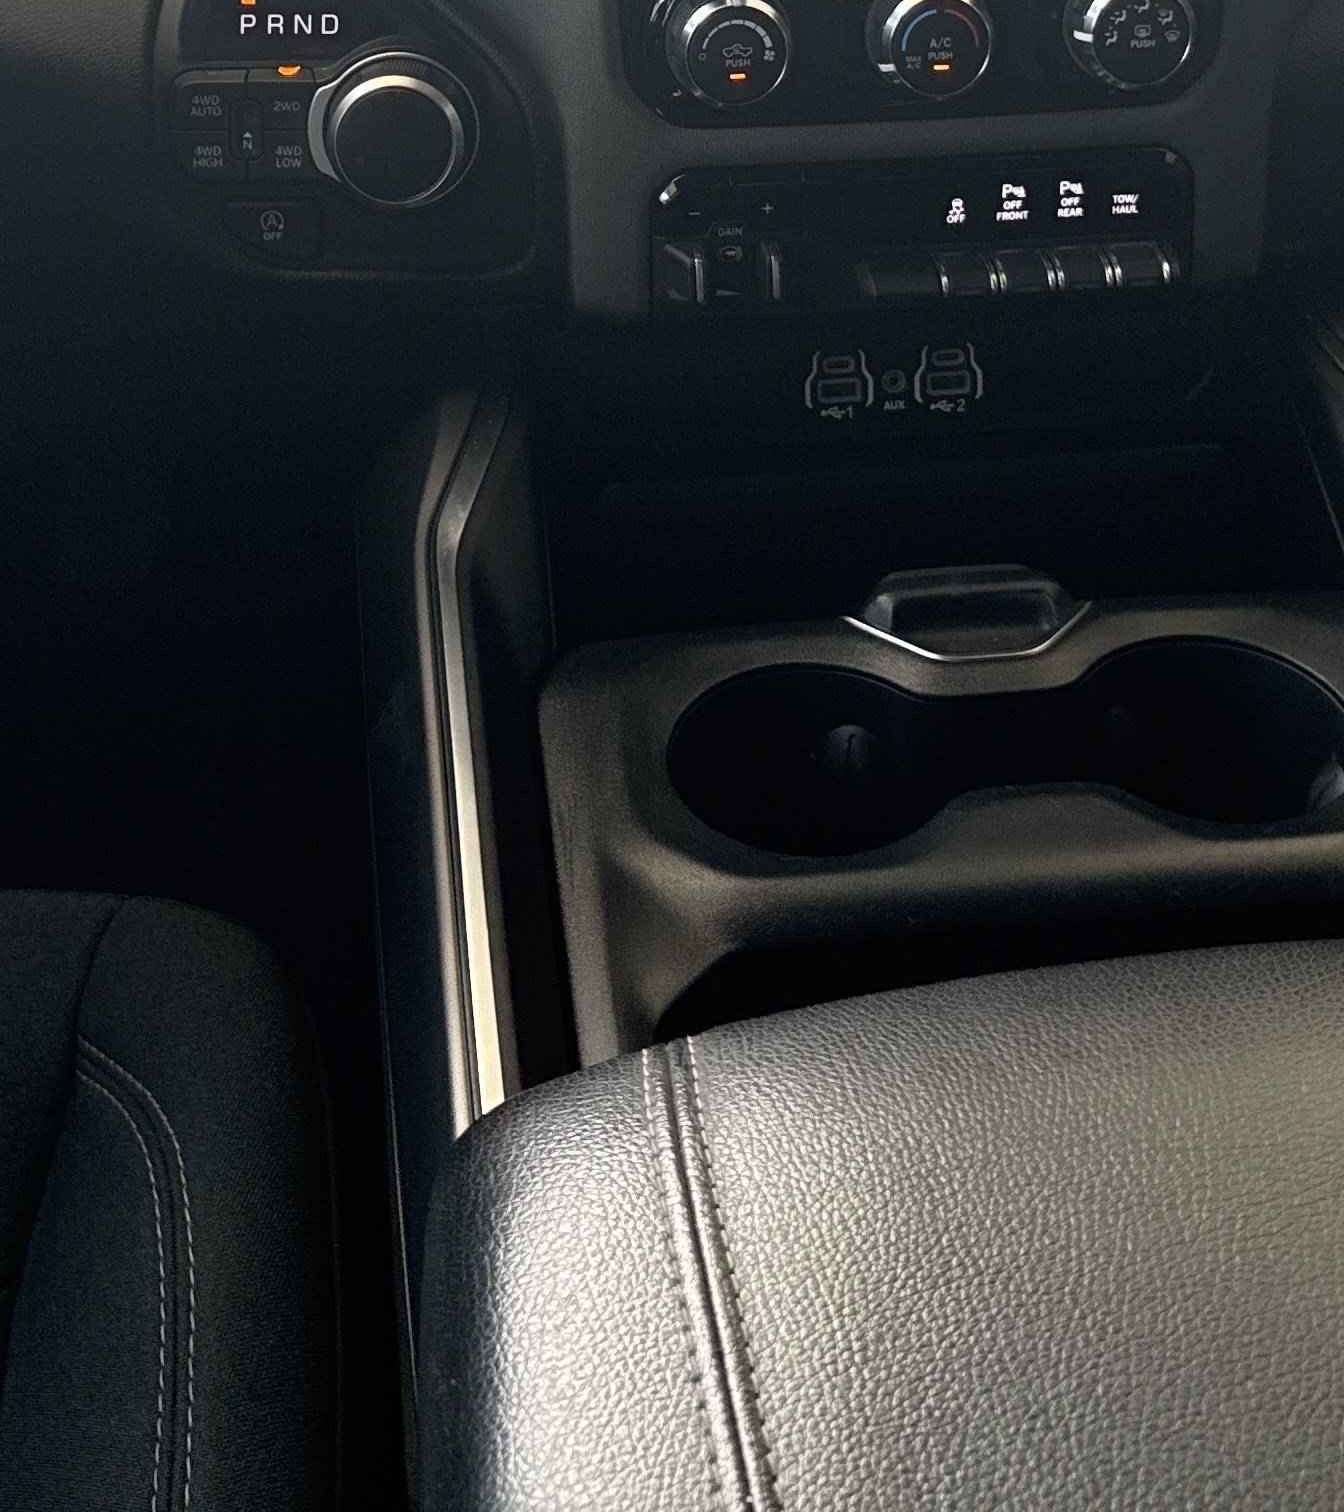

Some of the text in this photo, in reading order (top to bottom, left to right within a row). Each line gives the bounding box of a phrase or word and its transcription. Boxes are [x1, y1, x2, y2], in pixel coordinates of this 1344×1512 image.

[929, 37, 953, 49] A/C
[1129, 39, 1157, 49] PUSH
[927, 50, 954, 62] PUSH
[725, 57, 752, 68] PUSH
[192, 94, 220, 107] 4WD
[272, 100, 301, 113] 2WD
[190, 105, 223, 117] AUTO
[193, 145, 222, 157] 4WD
[242, 139, 253, 151] N
[274, 145, 303, 157] 4WD
[192, 157, 224, 169] HIGH
[274, 157, 303, 169] LOW
[1002, 199, 1023, 210] OFF
[1060, 196, 1082, 207] OFF
[995, 209, 1030, 222] FRONT
[1057, 207, 1084, 218] REAR
[1112, 204, 1139, 215] HAUL
[945, 213, 966, 224] OFF
[263, 231, 284, 241] OFF
[717, 226, 744, 238] GAIN
[883, 399, 906, 411] AUX
[956, 398, 967, 413] 2
